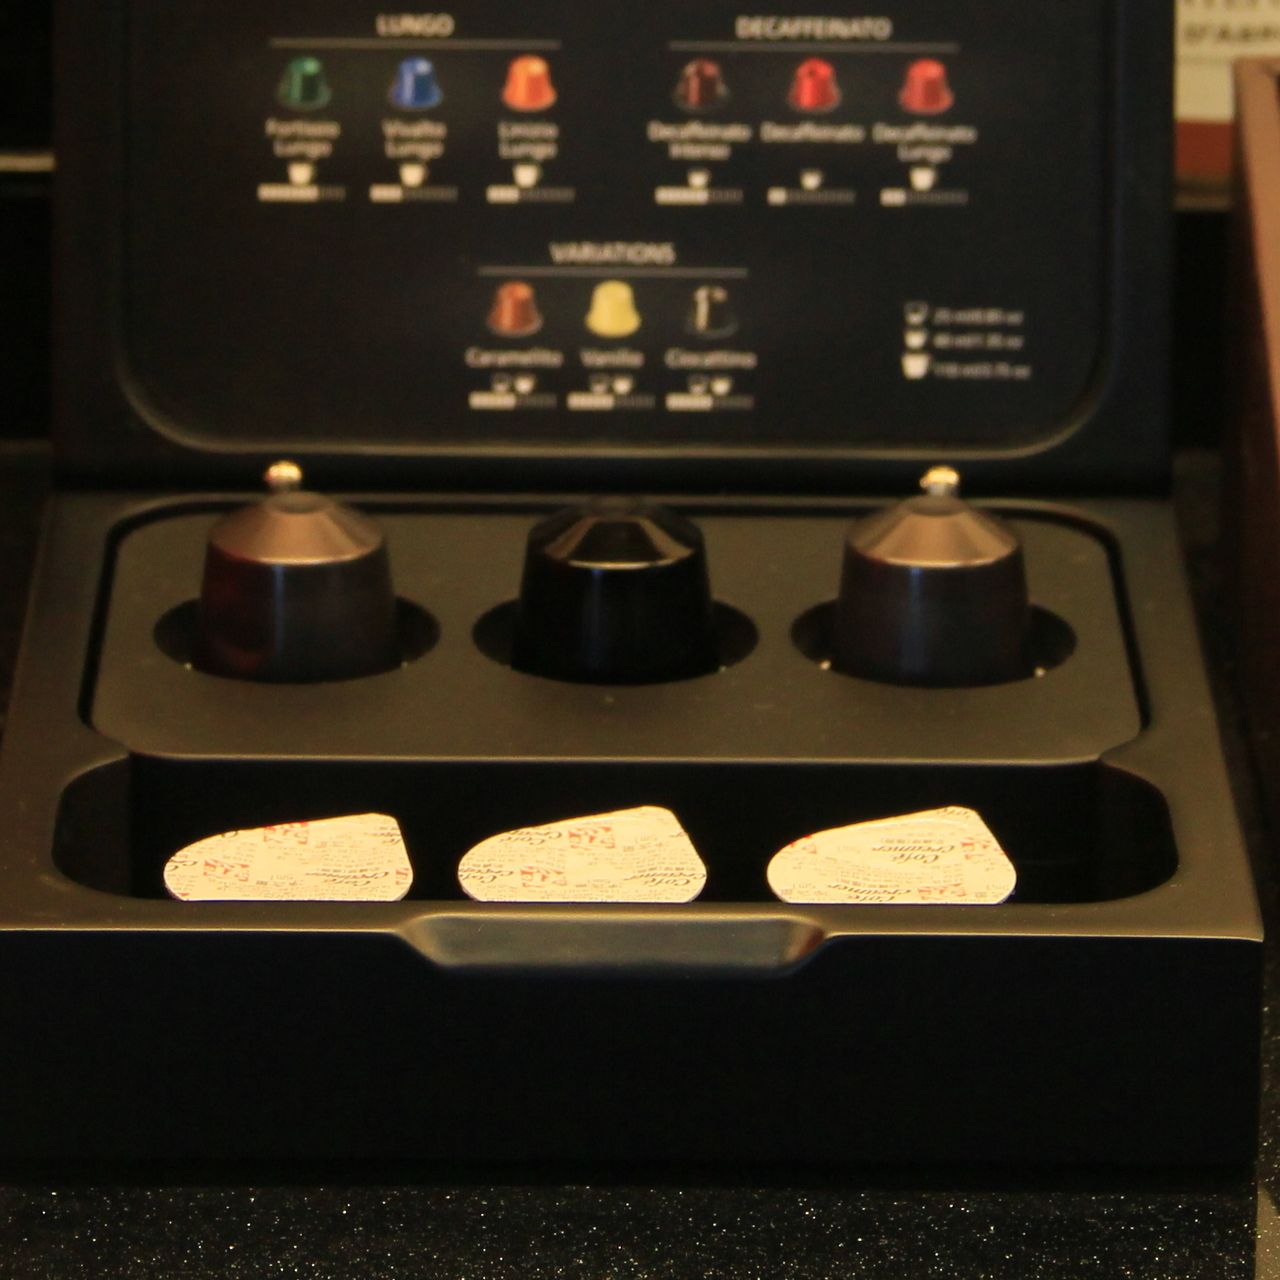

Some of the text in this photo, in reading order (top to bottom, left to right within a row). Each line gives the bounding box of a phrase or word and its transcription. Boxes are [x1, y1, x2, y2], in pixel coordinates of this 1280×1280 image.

[376, 13, 455, 36] LUNGO
[735, 15, 893, 40] DECAFFEINATO
[549, 241, 676, 265] VARIATIONS
